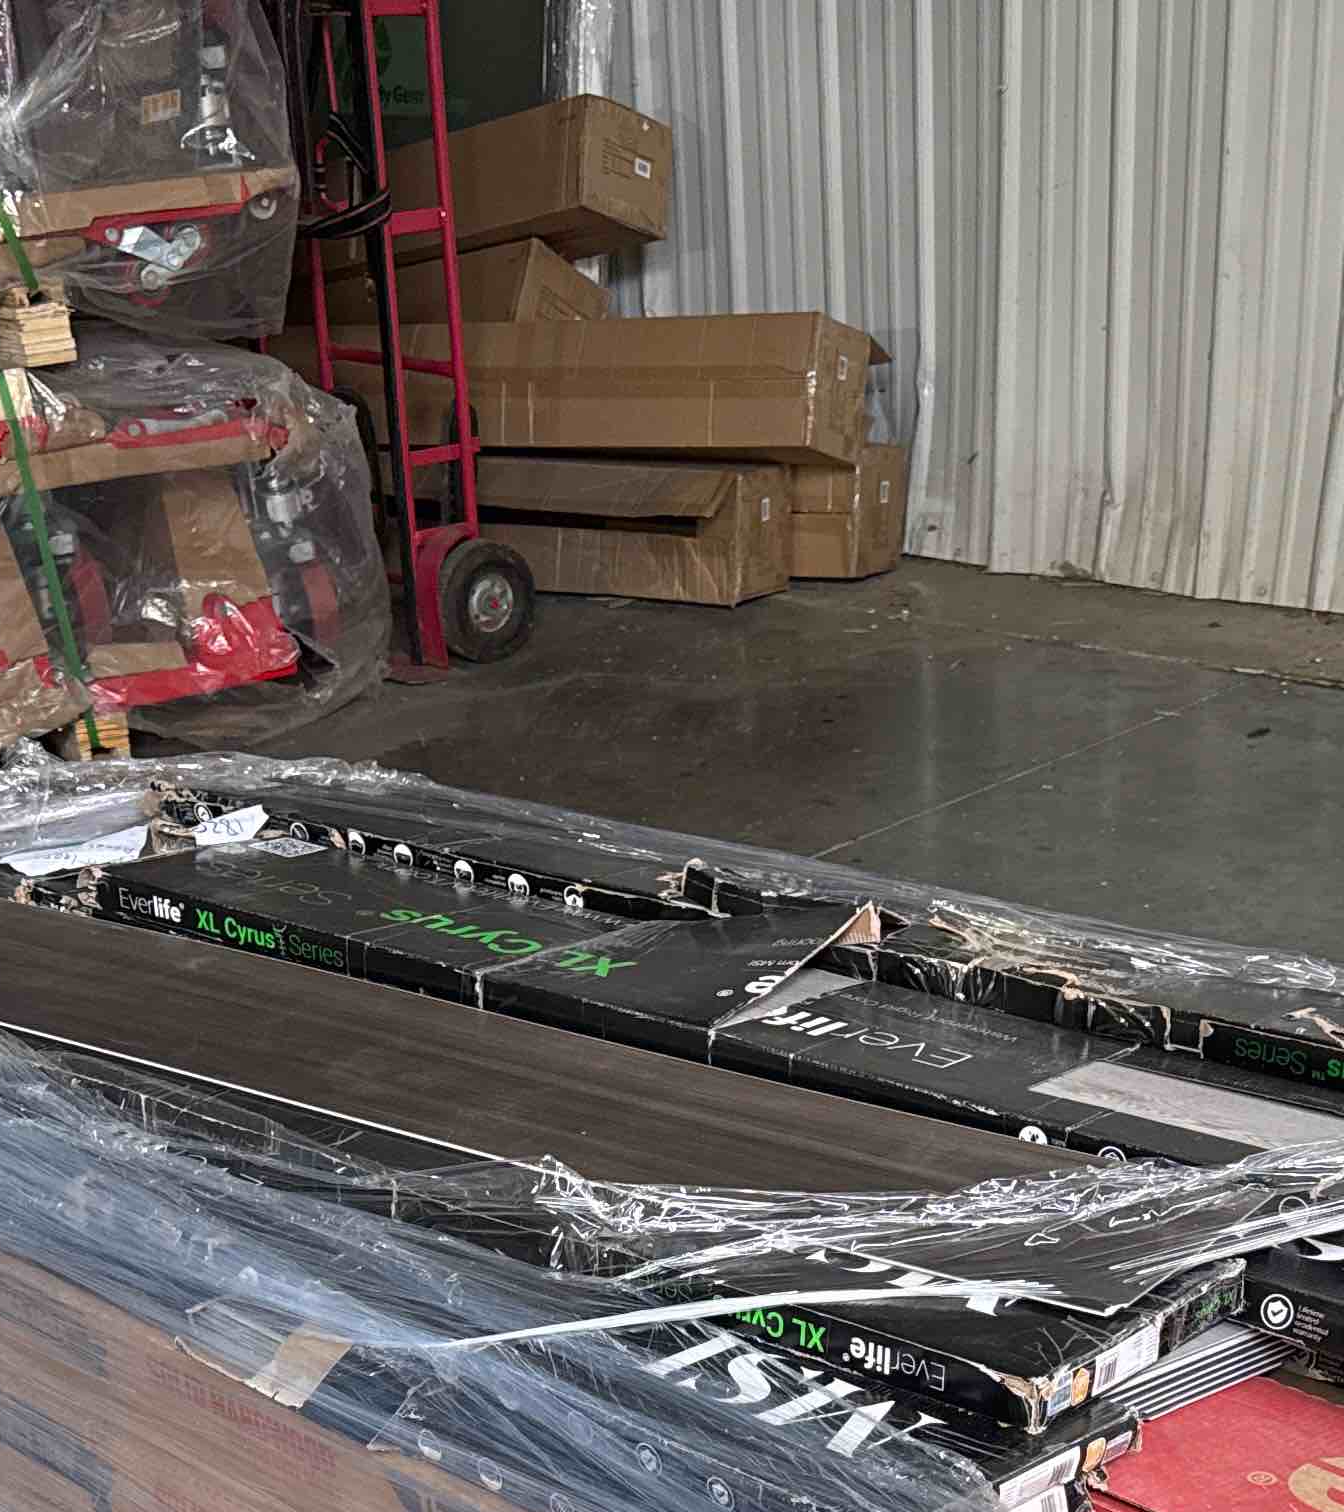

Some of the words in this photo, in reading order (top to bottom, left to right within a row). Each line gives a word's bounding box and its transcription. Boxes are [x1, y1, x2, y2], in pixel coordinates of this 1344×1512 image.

[119, 887, 183, 923] Everlife
[195, 908, 219, 933] XL
[225, 918, 276, 949] Cyrus
[289, 934, 345, 967] Series
[380, 909, 543, 955] Cyrus
[558, 950, 638, 977] XL
[1234, 1037, 1306, 1075] Series
[791, 1317, 828, 1353] XL
[846, 1336, 946, 1392] Everlife
[647, 1333, 949, 1458] MSI
